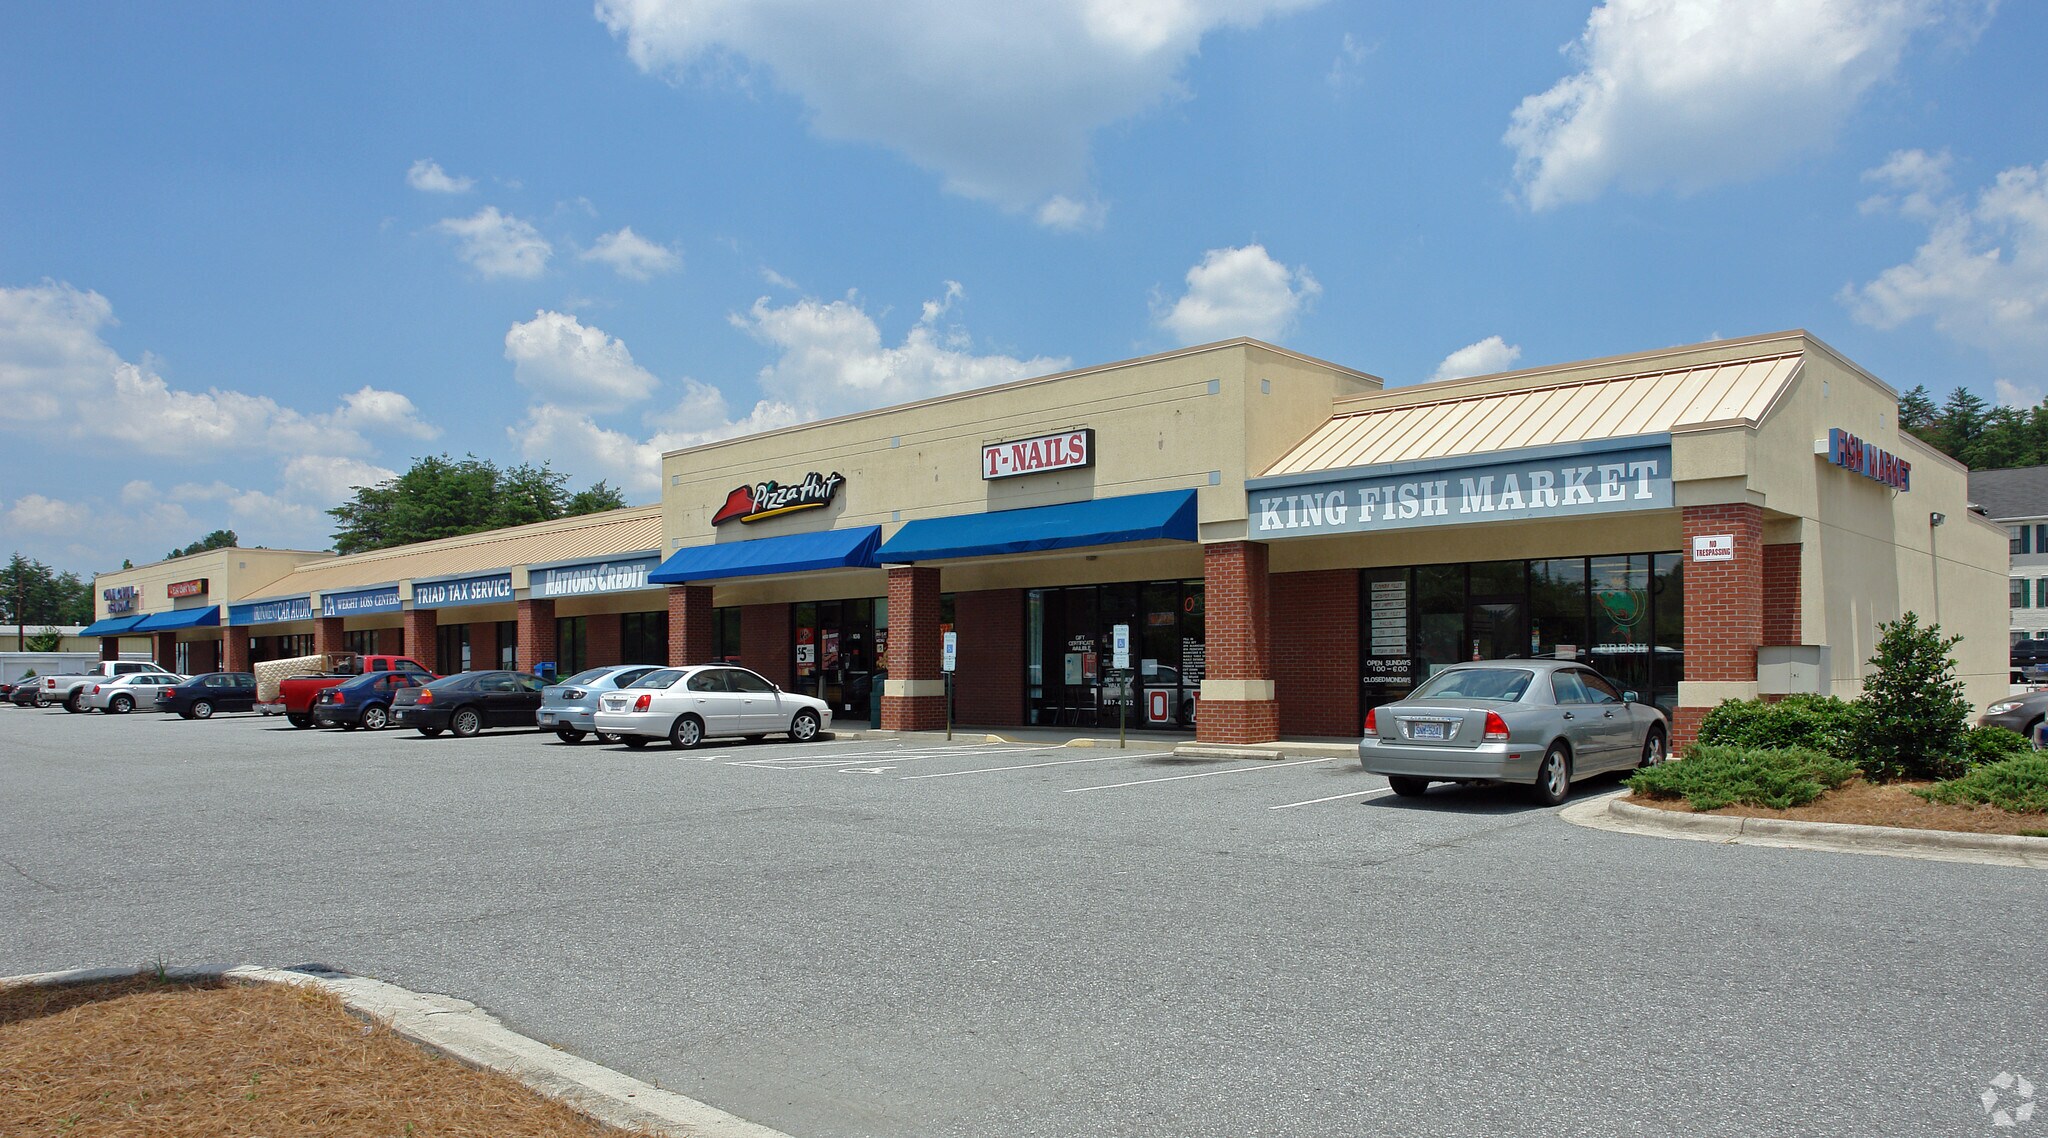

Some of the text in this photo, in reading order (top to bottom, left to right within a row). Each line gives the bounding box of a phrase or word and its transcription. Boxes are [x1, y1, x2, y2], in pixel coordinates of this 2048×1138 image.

[986, 434, 1085, 475] T-NAILS
[1833, 428, 1911, 491] FISH MARKET
[753, 473, 841, 513] Pizza Hut
[1258, 460, 1658, 531] KING FISH MARKET
[1696, 547, 1731, 557] TRESPASSING
[1709, 540, 1717, 548] NO
[337, 598, 358, 610] WEIGHT
[360, 596, 373, 608] LOSS
[374, 593, 400, 607] CENTERS
[416, 579, 511, 604] TRIAD TAX SERVICE
[278, 602, 290, 620] CAR
[291, 599, 312, 619] AUDIO
[1599, 643, 1648, 653] FRESH
